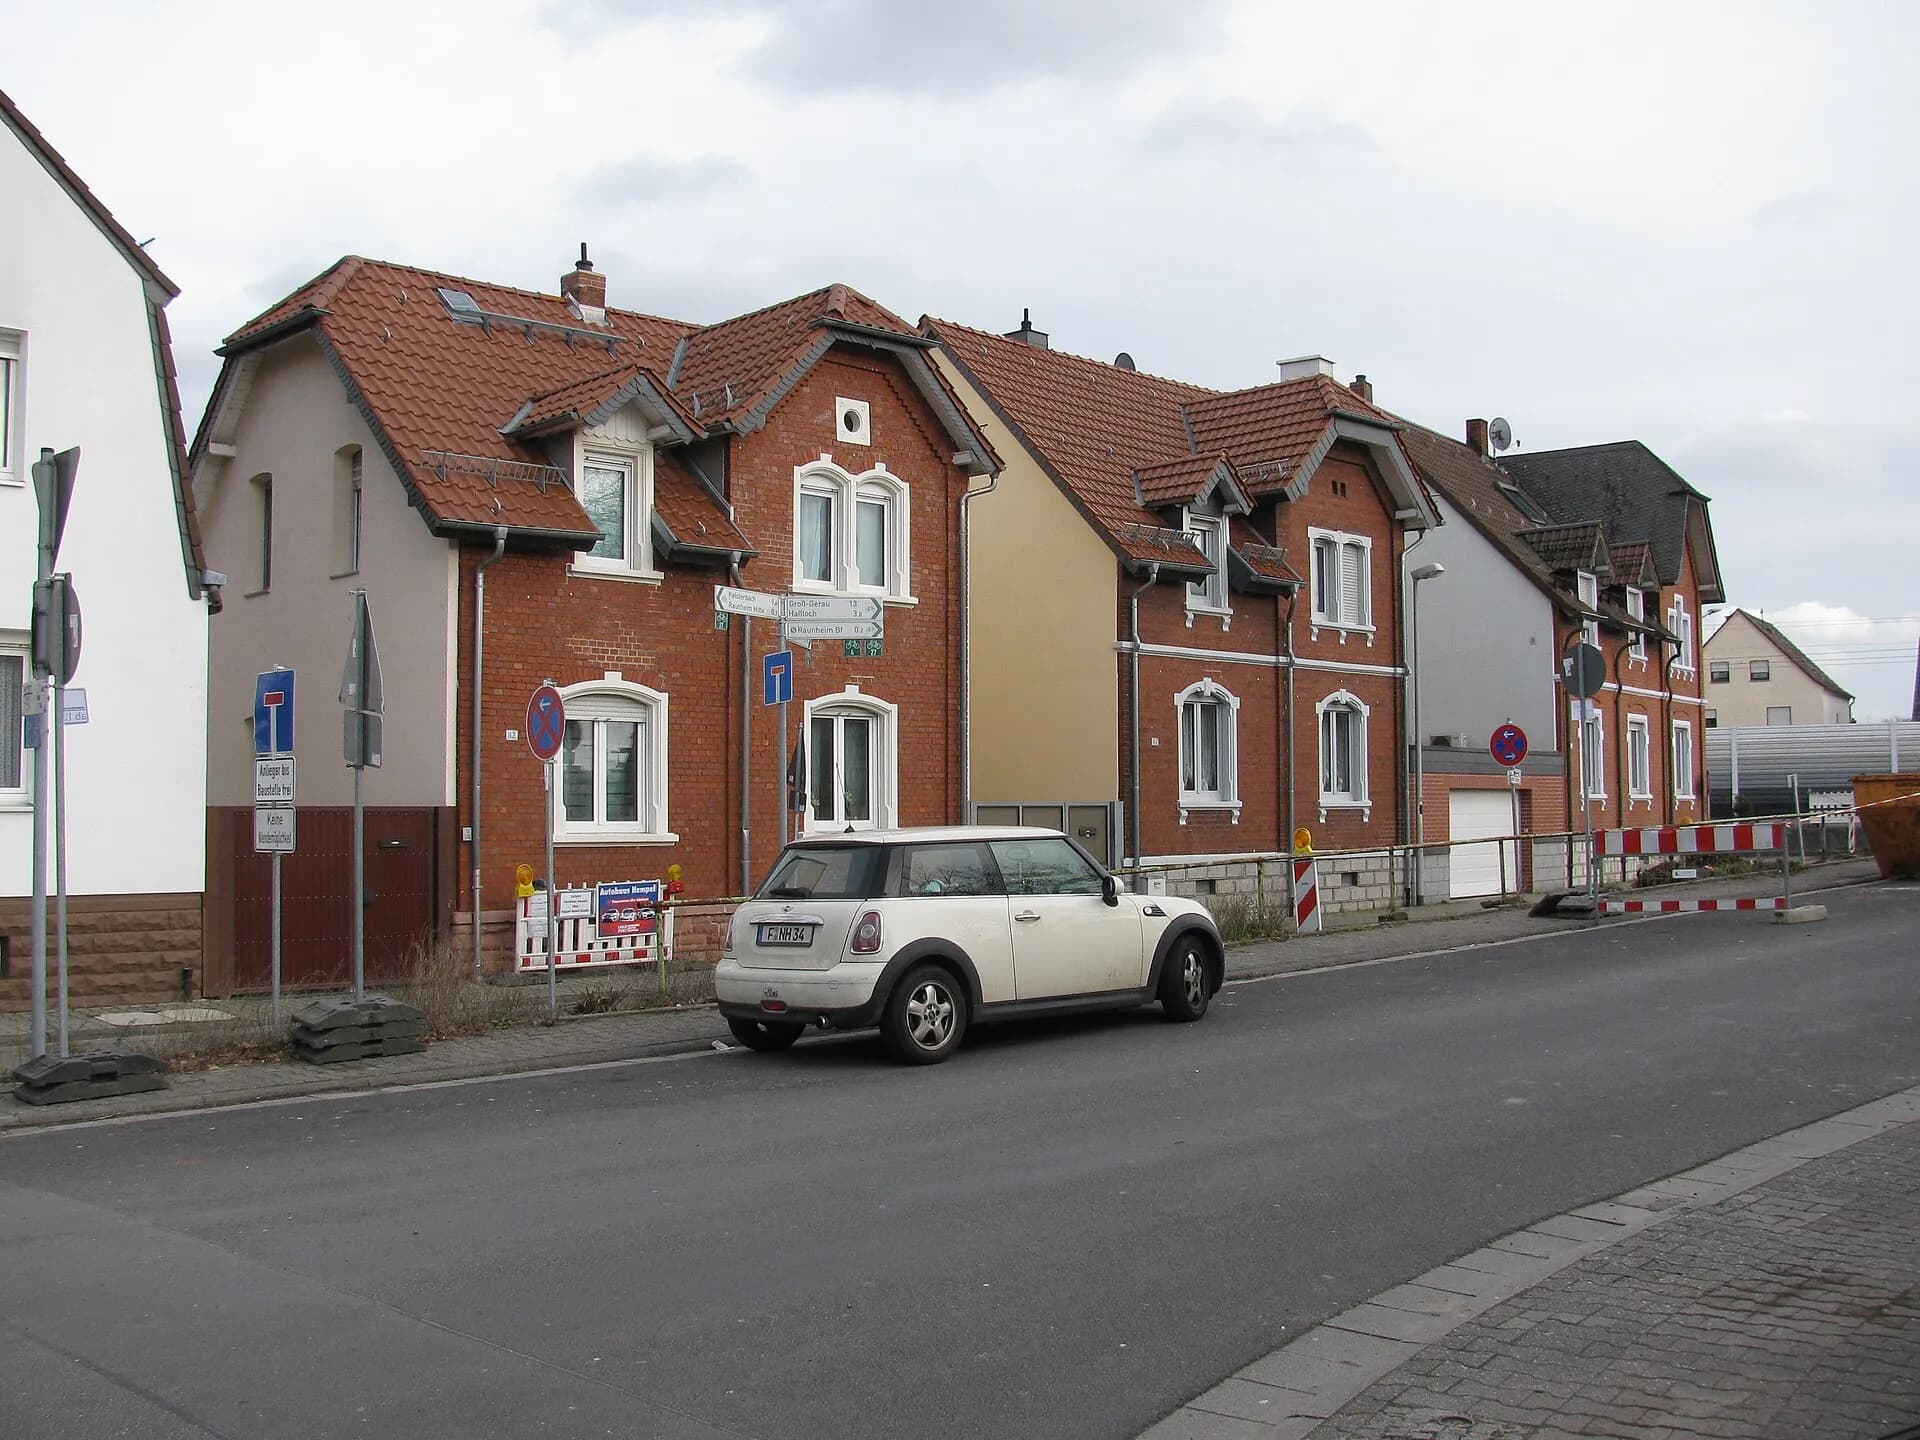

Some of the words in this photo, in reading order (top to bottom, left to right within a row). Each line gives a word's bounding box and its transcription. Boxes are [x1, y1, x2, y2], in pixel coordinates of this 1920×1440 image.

[789, 600, 831, 608] Groß-Gerau
[797, 626, 834, 634] Raunheim
[260, 764, 281, 780] Anlieger
[281, 763, 290, 776] bis
[258, 784, 281, 796] Baustelle
[282, 783, 292, 796] frei
[267, 813, 283, 825] Keine
[599, 886, 630, 896] Autohaus
[631, 884, 656, 895] Hempel
[768, 927, 774, 940] F
[779, 927, 792, 941] NH
[792, 927, 805, 941] 34
